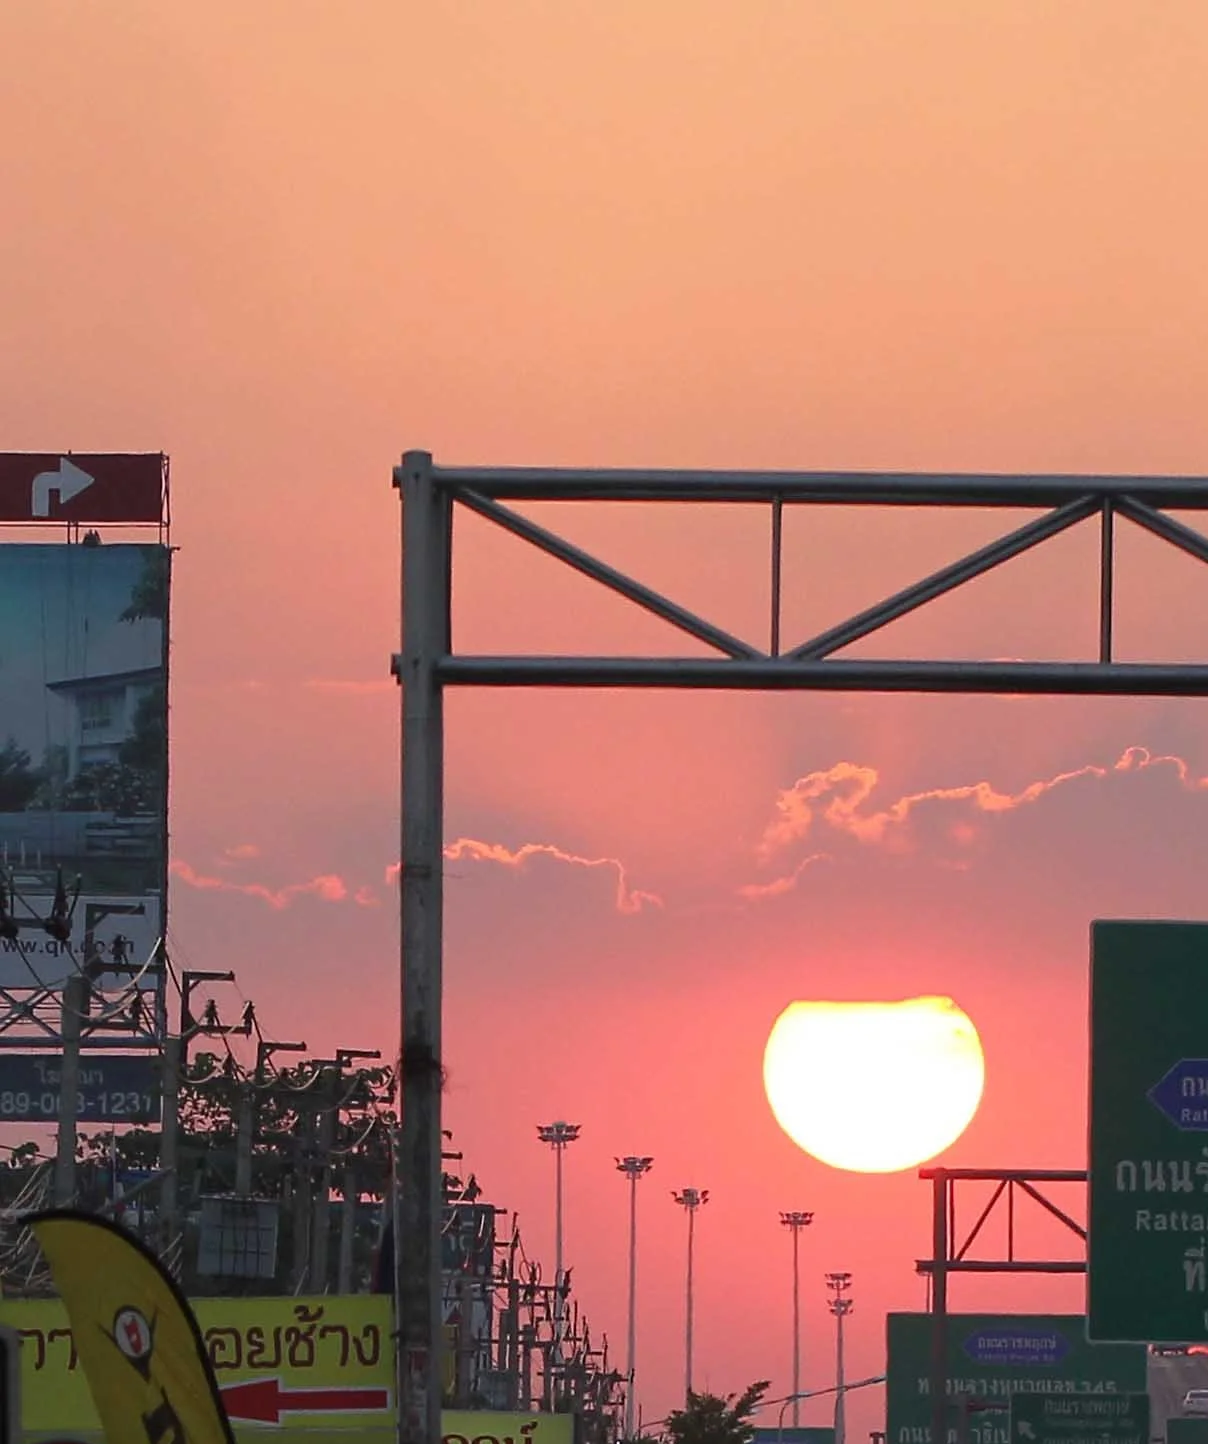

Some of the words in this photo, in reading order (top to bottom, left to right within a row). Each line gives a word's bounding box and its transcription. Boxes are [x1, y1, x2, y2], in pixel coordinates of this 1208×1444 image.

[917, 1377, 1074, 1396] ทงหลวงหมายเลข
